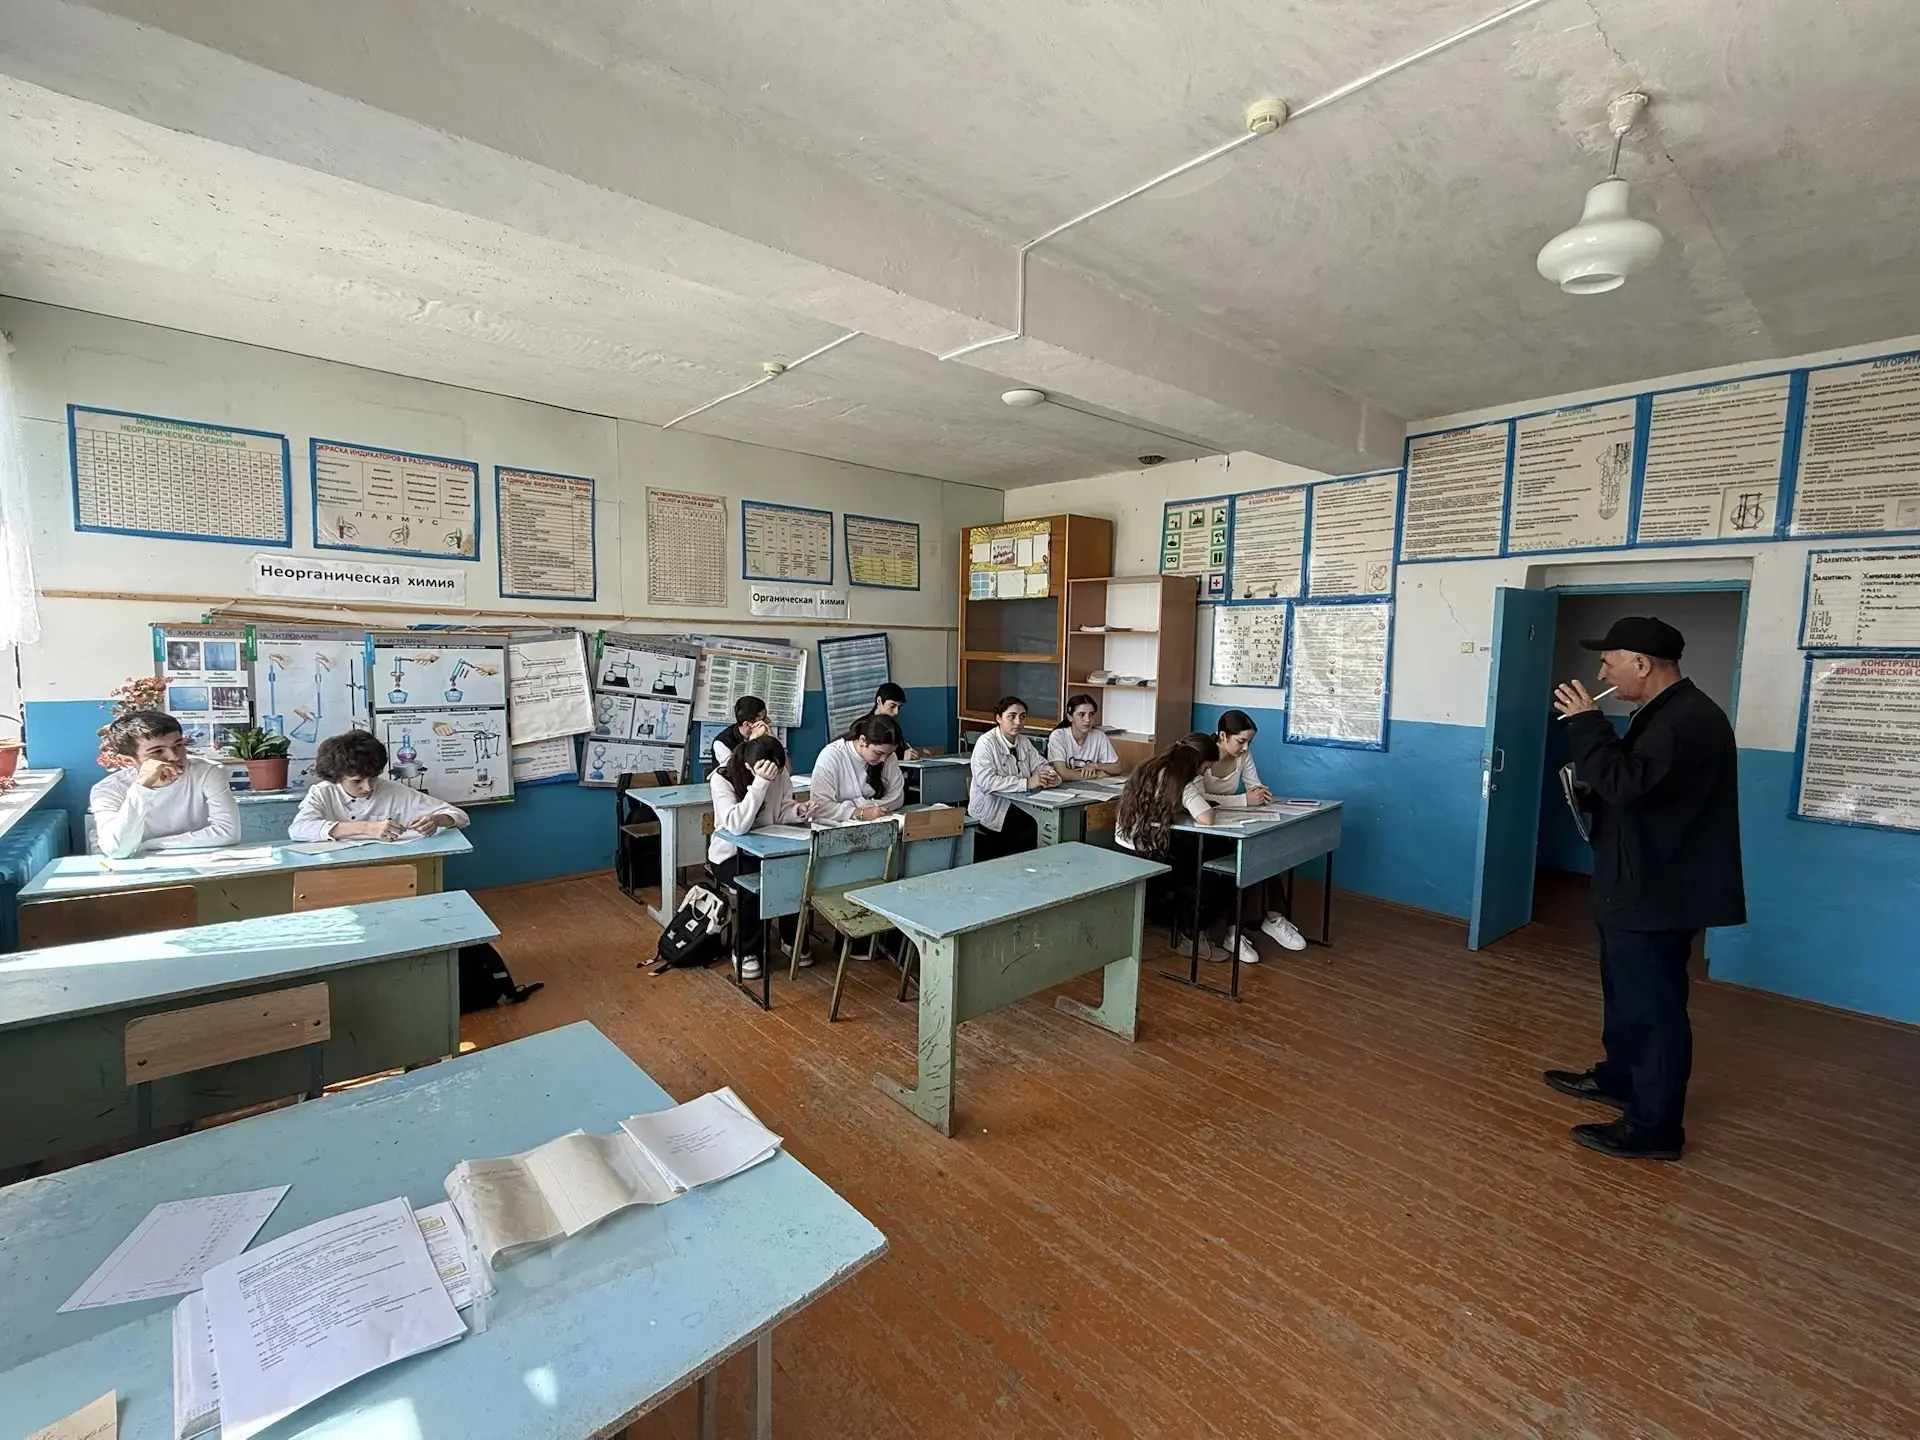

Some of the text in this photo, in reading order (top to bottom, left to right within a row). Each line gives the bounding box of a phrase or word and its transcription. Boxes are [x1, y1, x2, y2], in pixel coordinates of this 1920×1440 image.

[1697, 384, 1740, 396] АЛГОРИТМ
[136, 418, 232, 438] МОЛЕКУЛЯРНЫЕ МАССЫ
[120, 424, 246, 447] НЕОРГАНИЧЕСКИХ СОЕДИНЕНИЙ
[350, 449, 401, 462] ИНДИКАТОРОВ
[533, 481, 567, 490] ФИЗИЧЕСКИХ
[650, 491, 690, 500] РАСТВОРИМОСТЬ
[261, 565, 455, 588] Неорганическая химия
[753, 593, 813, 604] Органическая
[177, 630, 235, 638] ХИМИЧЕСКАЯ
[271, 632, 318, 640] ТИТРОВАНИЕ
